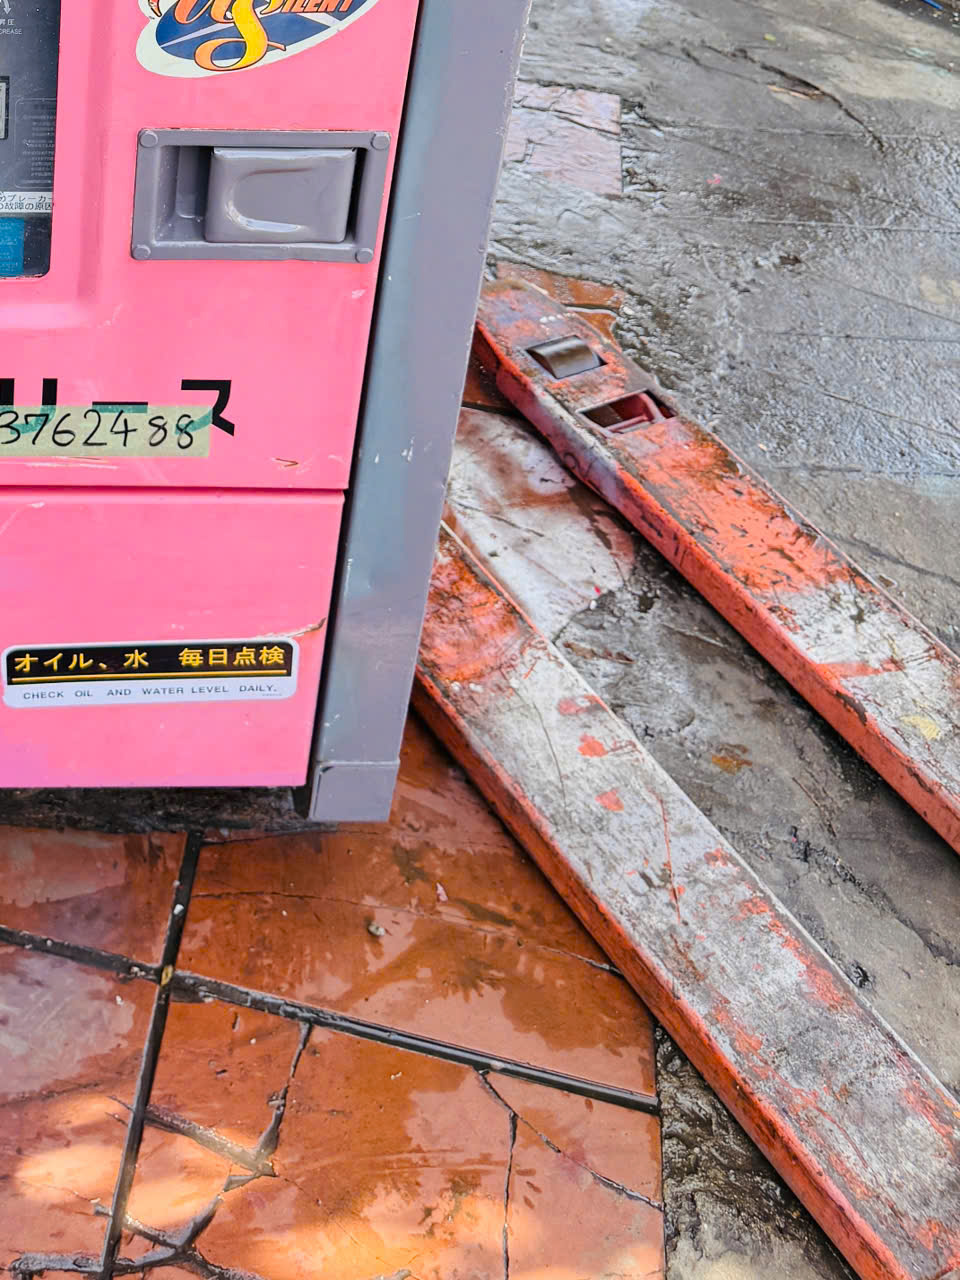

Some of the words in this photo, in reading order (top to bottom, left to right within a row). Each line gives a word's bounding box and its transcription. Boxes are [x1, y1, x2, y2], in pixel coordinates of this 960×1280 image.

[13, 648, 150, 672] オイル、水
[178, 645, 286, 666] 毎日点検
[23, 690, 65, 700] CHECK
[74, 689, 94, 697] OIL
[106, 687, 132, 697] AND
[141, 686, 185, 696] WATER
[190, 685, 229, 694] LEVEL
[239, 683, 278, 693] DAILY.
